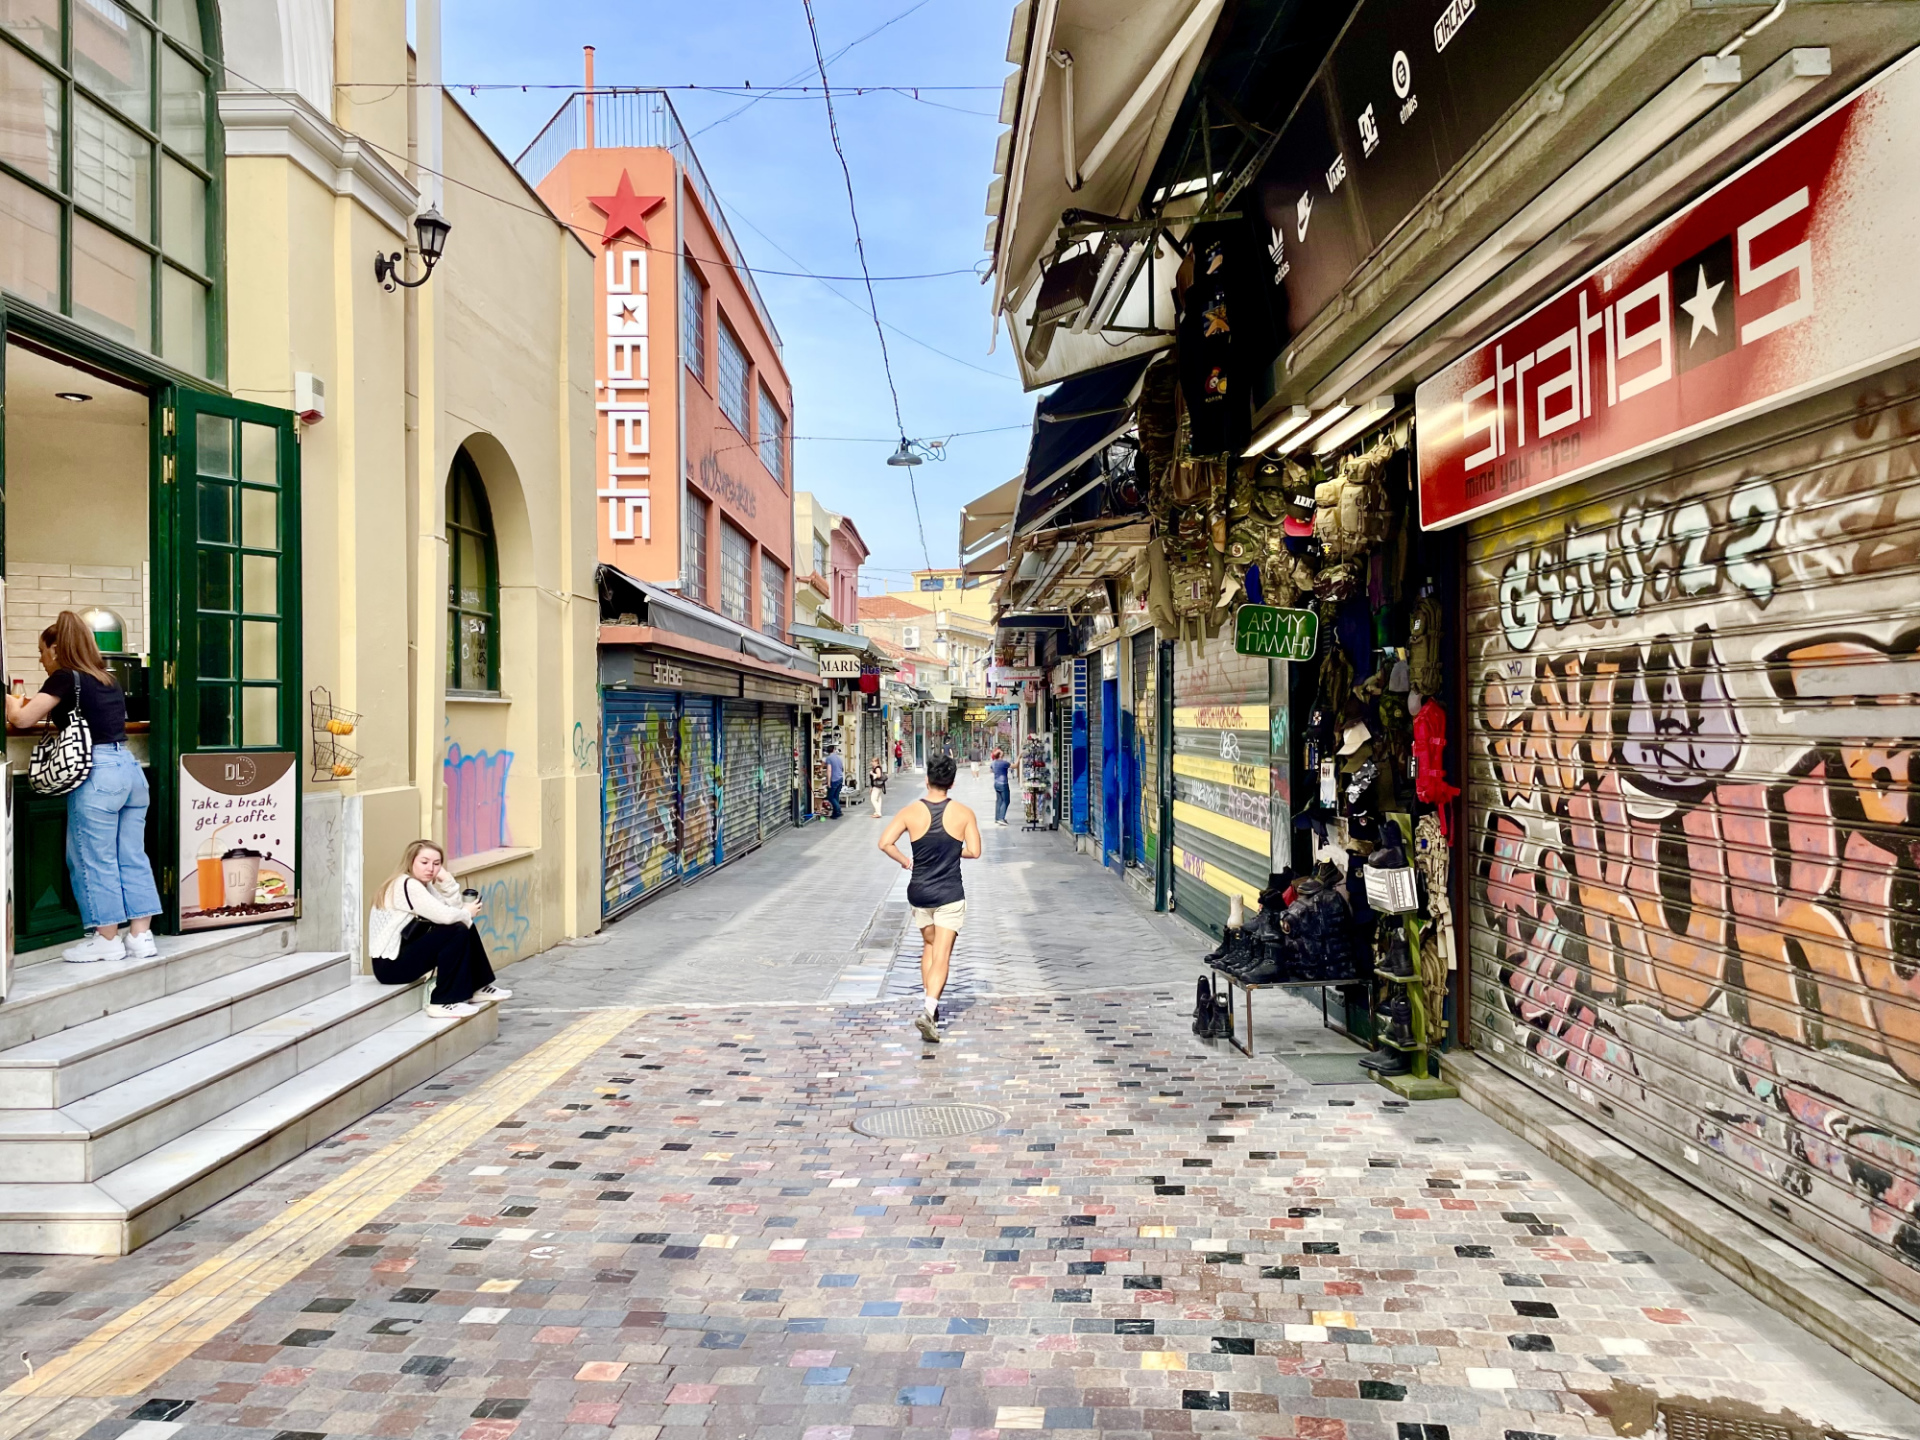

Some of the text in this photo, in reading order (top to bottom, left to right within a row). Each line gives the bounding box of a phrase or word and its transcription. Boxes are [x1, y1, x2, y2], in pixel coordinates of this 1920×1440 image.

[1435, 0, 1463, 49] CIRCA
[1399, 95, 1418, 125] etnies
[1274, 261, 1290, 285] adidas
[1465, 431, 1581, 500] mind your step
[1293, 494, 1316, 509] ARMY
[1247, 611, 1306, 634] ARMY
[820, 660, 860, 673] MARIS
[224, 762, 245, 781] DL
[191, 794, 278, 810] Take a break,
[194, 810, 277, 831] get a coffee
[228, 872, 246, 888] DL
